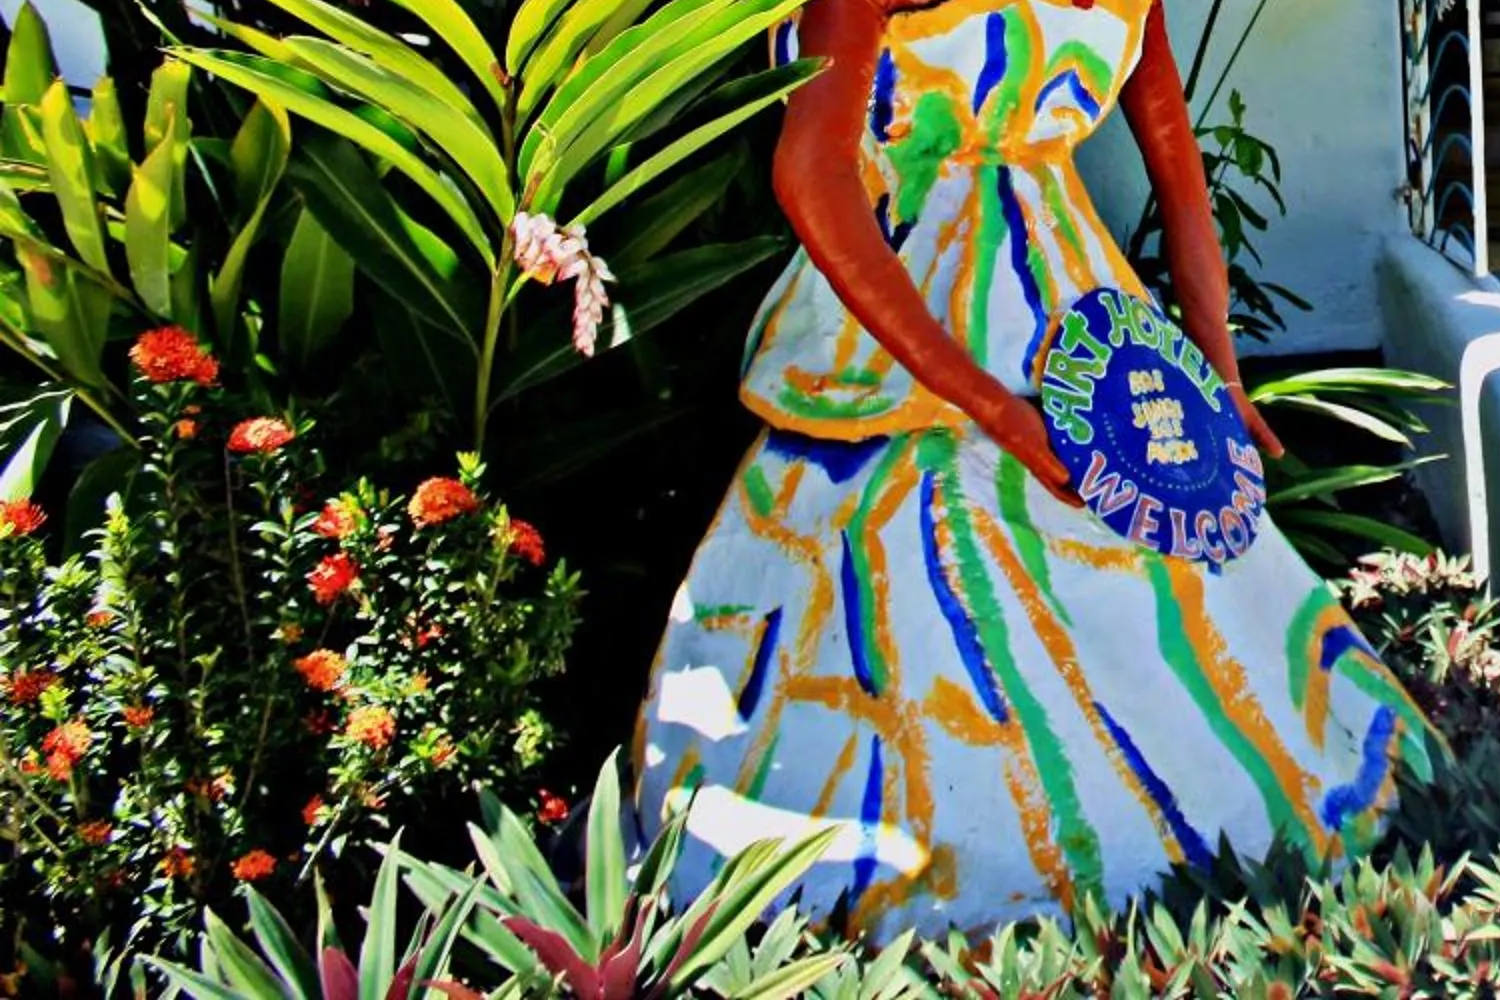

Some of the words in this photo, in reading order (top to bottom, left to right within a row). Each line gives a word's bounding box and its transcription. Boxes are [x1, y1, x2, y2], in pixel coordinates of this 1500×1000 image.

[1041, 310, 1113, 445] ART
[1098, 291, 1226, 413] HOTEL
[1078, 437, 1265, 563] WELCOME
